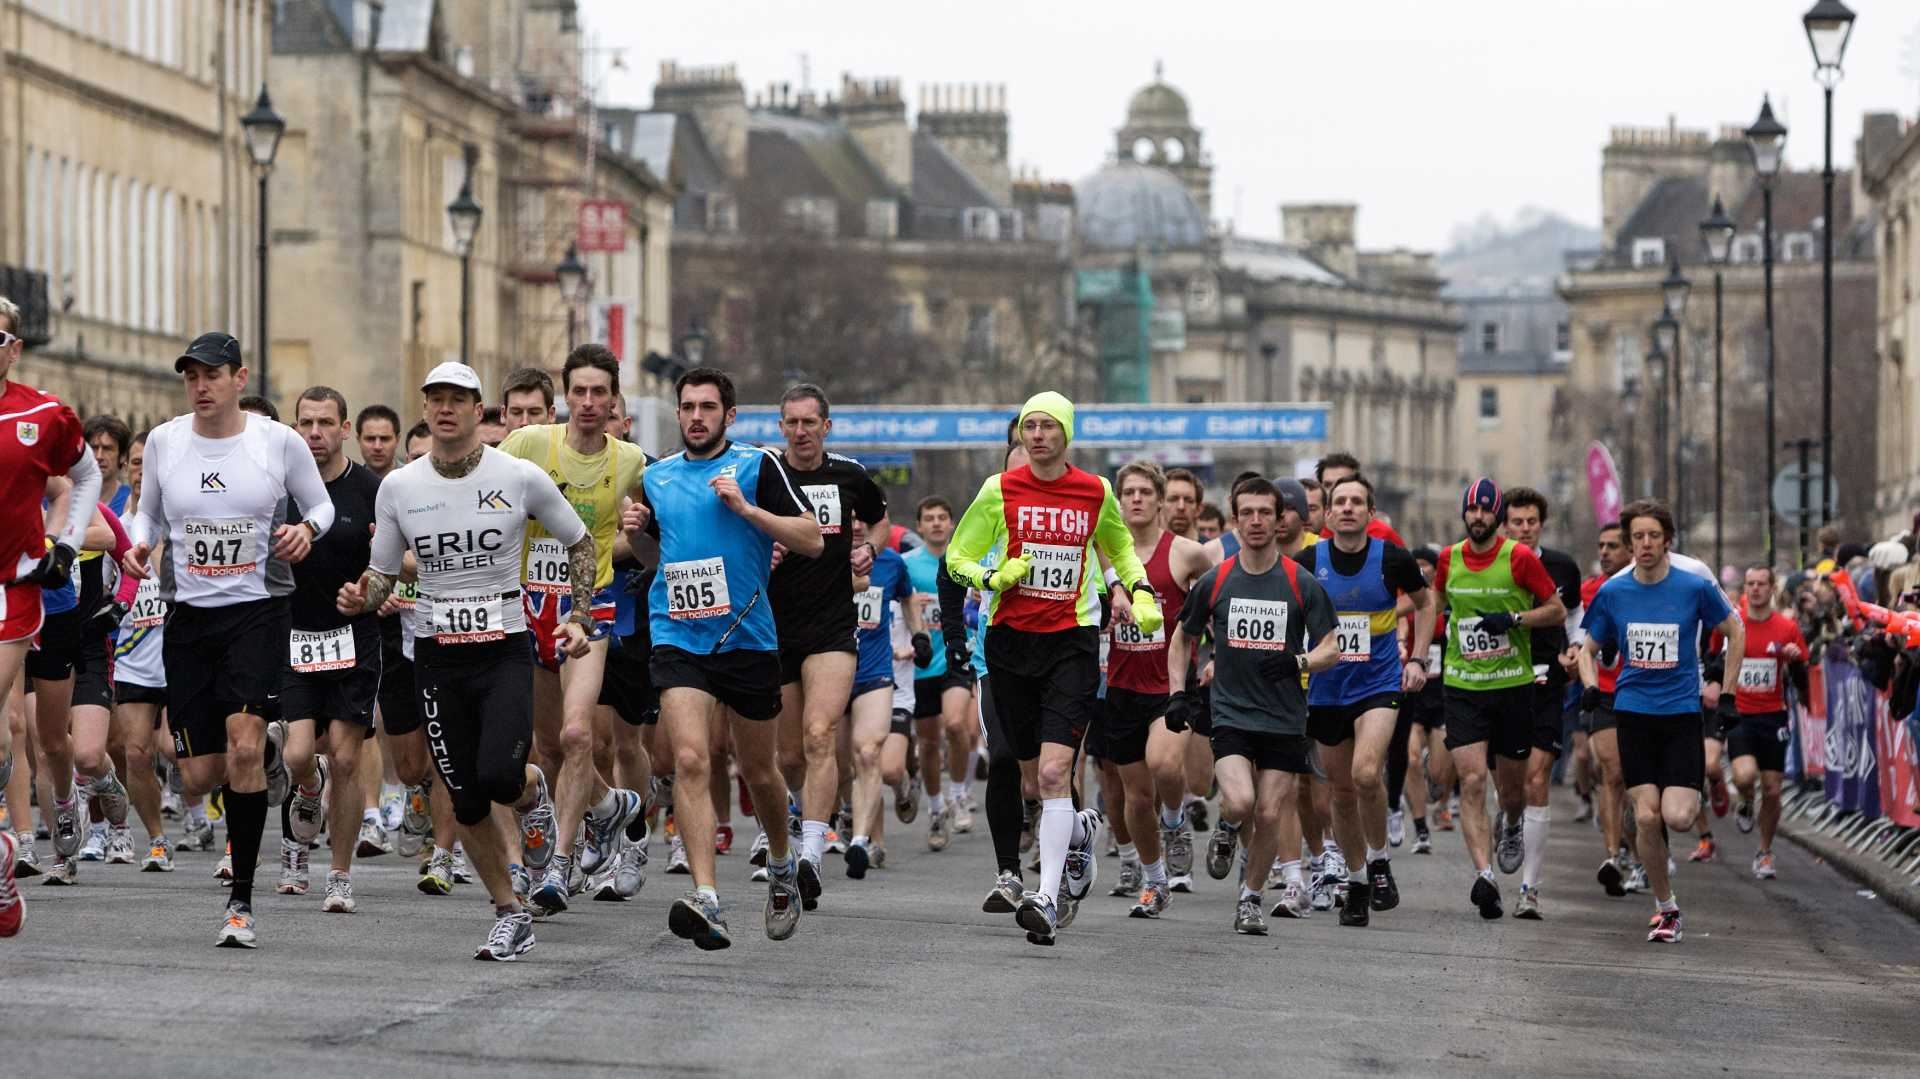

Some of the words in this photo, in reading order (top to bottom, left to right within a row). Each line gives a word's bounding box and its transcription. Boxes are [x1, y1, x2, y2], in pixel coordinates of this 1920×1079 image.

[185, 524, 218, 535] BATH
[221, 522, 254, 535] HALF
[1018, 506, 1089, 536] FETCH
[414, 529, 502, 559] ERIC
[529, 543, 559, 555] BATH
[194, 539, 242, 566] 947
[1055, 551, 1082, 562] HALF
[211, 565, 256, 577] balance
[422, 559, 456, 573] THE
[665, 569, 689, 581] BATH
[691, 564, 723, 579] HALF
[527, 584, 547, 593] new
[549, 585, 572, 595] bala
[673, 581, 716, 610] 505
[688, 606, 731, 619] balance
[1231, 605, 1257, 614] BATH
[1260, 607, 1287, 616] HALF
[445, 607, 489, 634] 109
[1344, 621, 1368, 630] HALF
[292, 633, 320, 643] BATH
[324, 625, 351, 640] HALF
[1237, 618, 1275, 641] 608
[438, 635, 459, 645] new
[461, 632, 505, 644] balance
[1466, 633, 1500, 653] 965
[301, 640, 341, 664] 811
[1247, 642, 1285, 651] balance
[1635, 641, 1666, 661] 571
